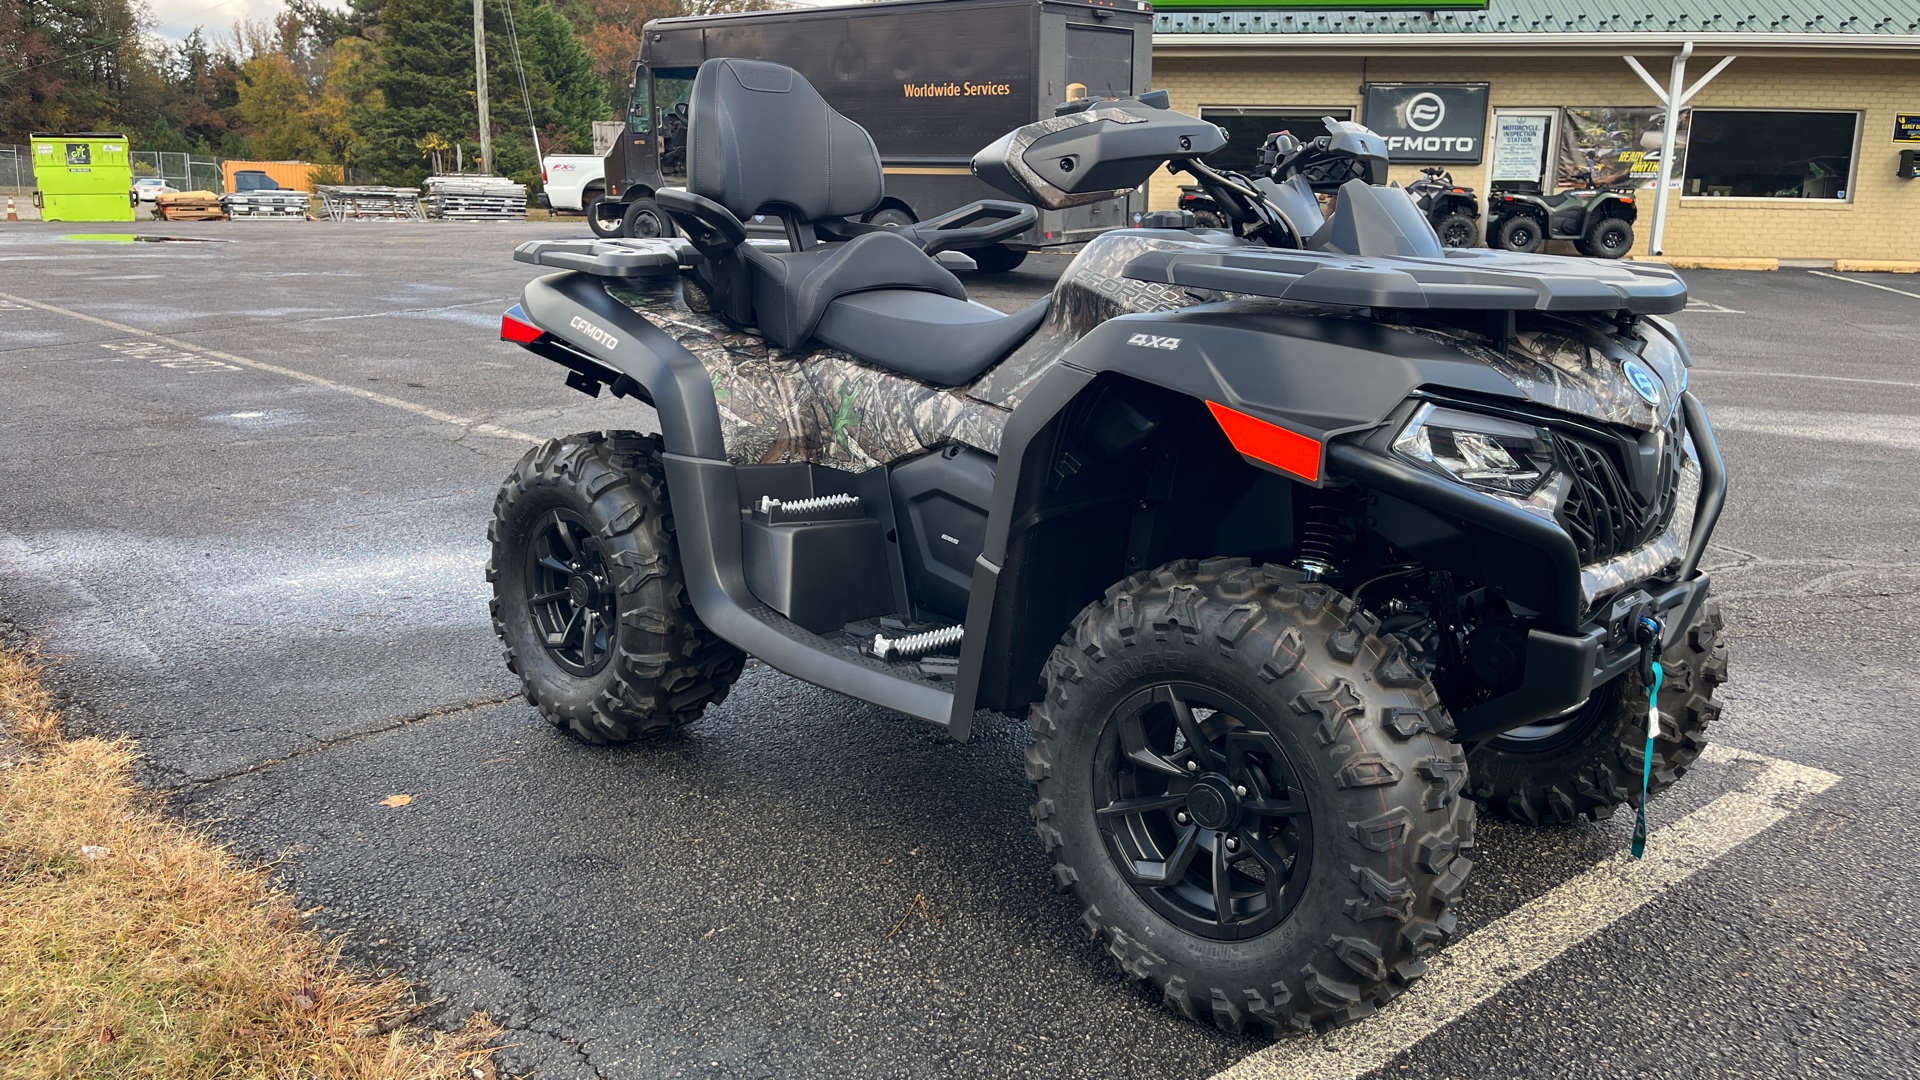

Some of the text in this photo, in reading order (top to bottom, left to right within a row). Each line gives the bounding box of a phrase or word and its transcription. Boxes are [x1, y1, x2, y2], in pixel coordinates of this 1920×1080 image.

[904, 81, 1010, 97] Worldwide Services
[1618, 151, 1646, 162] READY
[570, 315, 619, 350] CFMOTO
